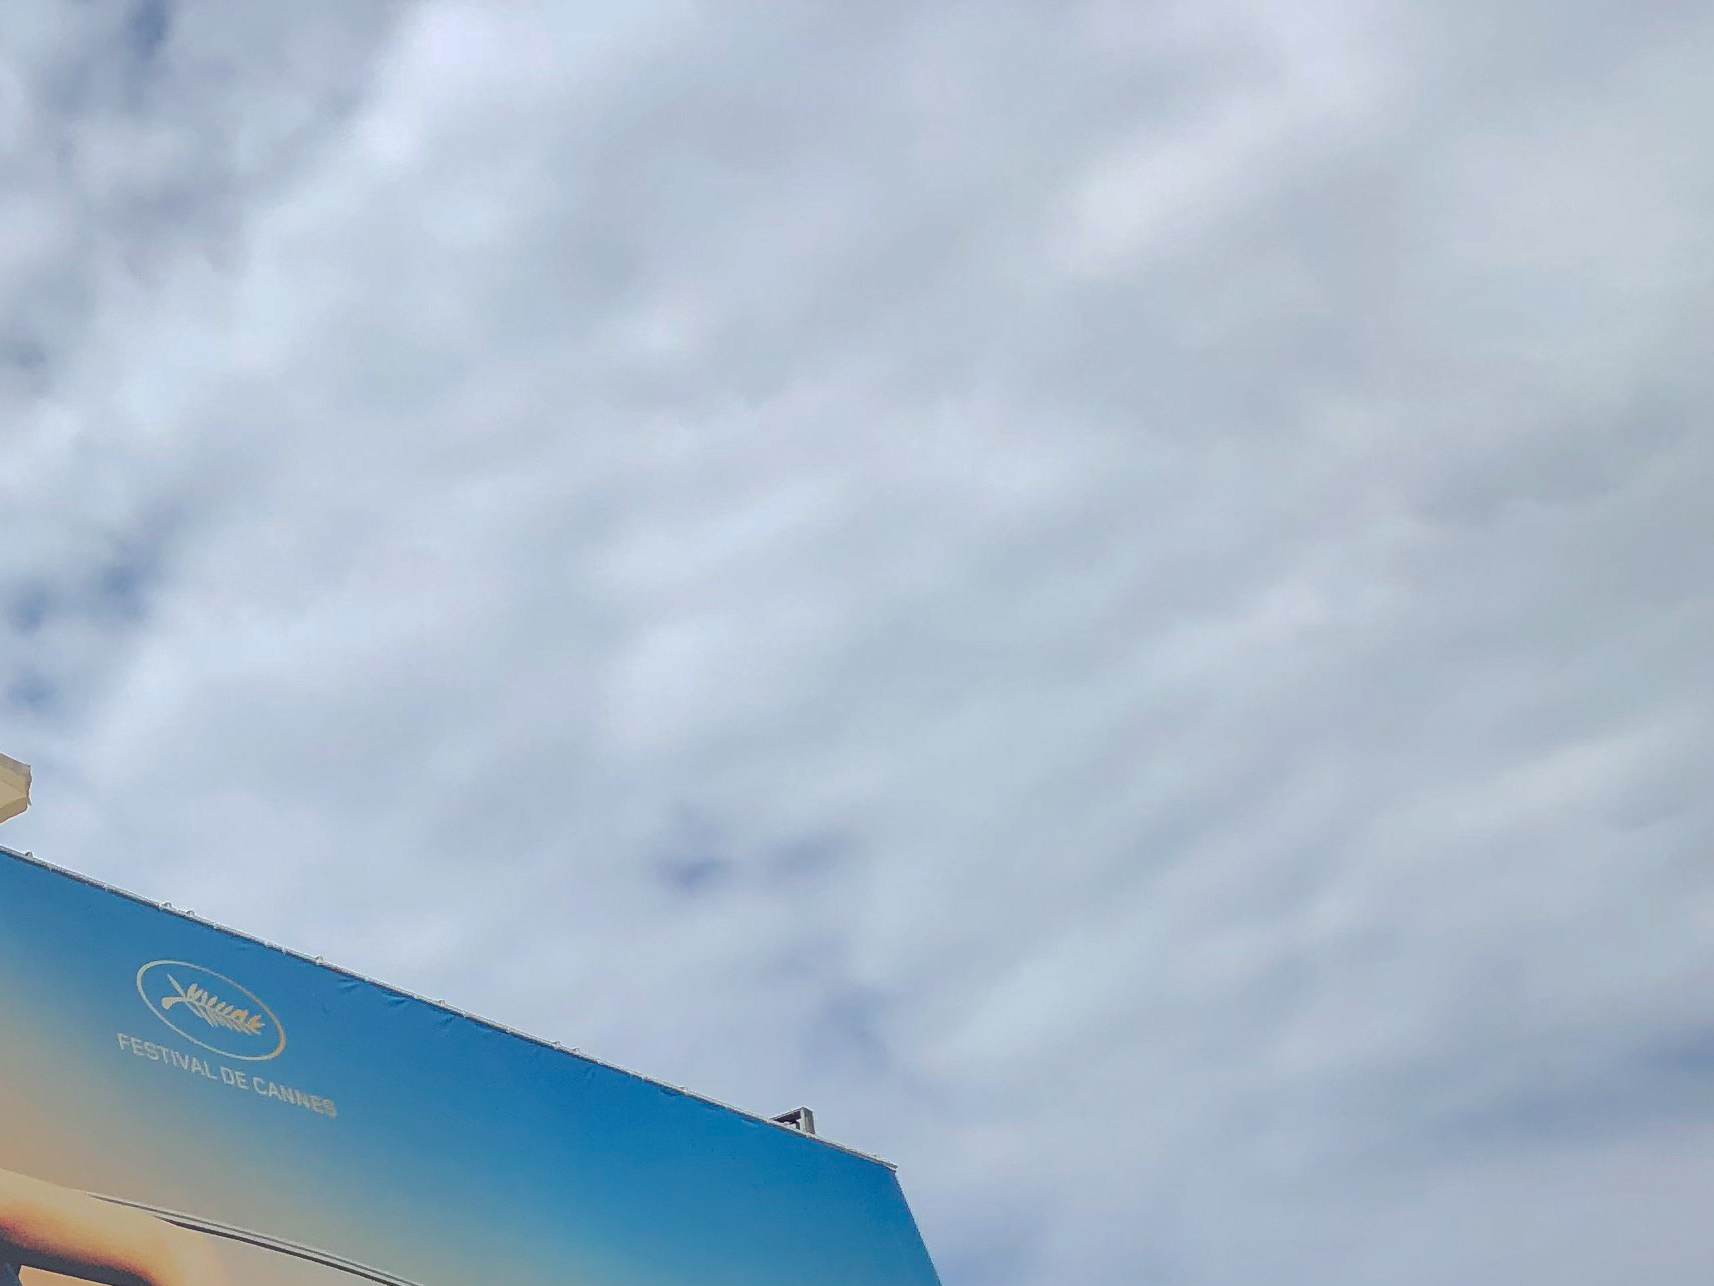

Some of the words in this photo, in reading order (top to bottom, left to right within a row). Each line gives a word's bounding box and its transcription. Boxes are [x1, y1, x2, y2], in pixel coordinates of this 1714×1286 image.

[116, 1032, 217, 1081] FESTIVAL
[219, 1065, 249, 1090] DE
[252, 1076, 337, 1119] CANNES
